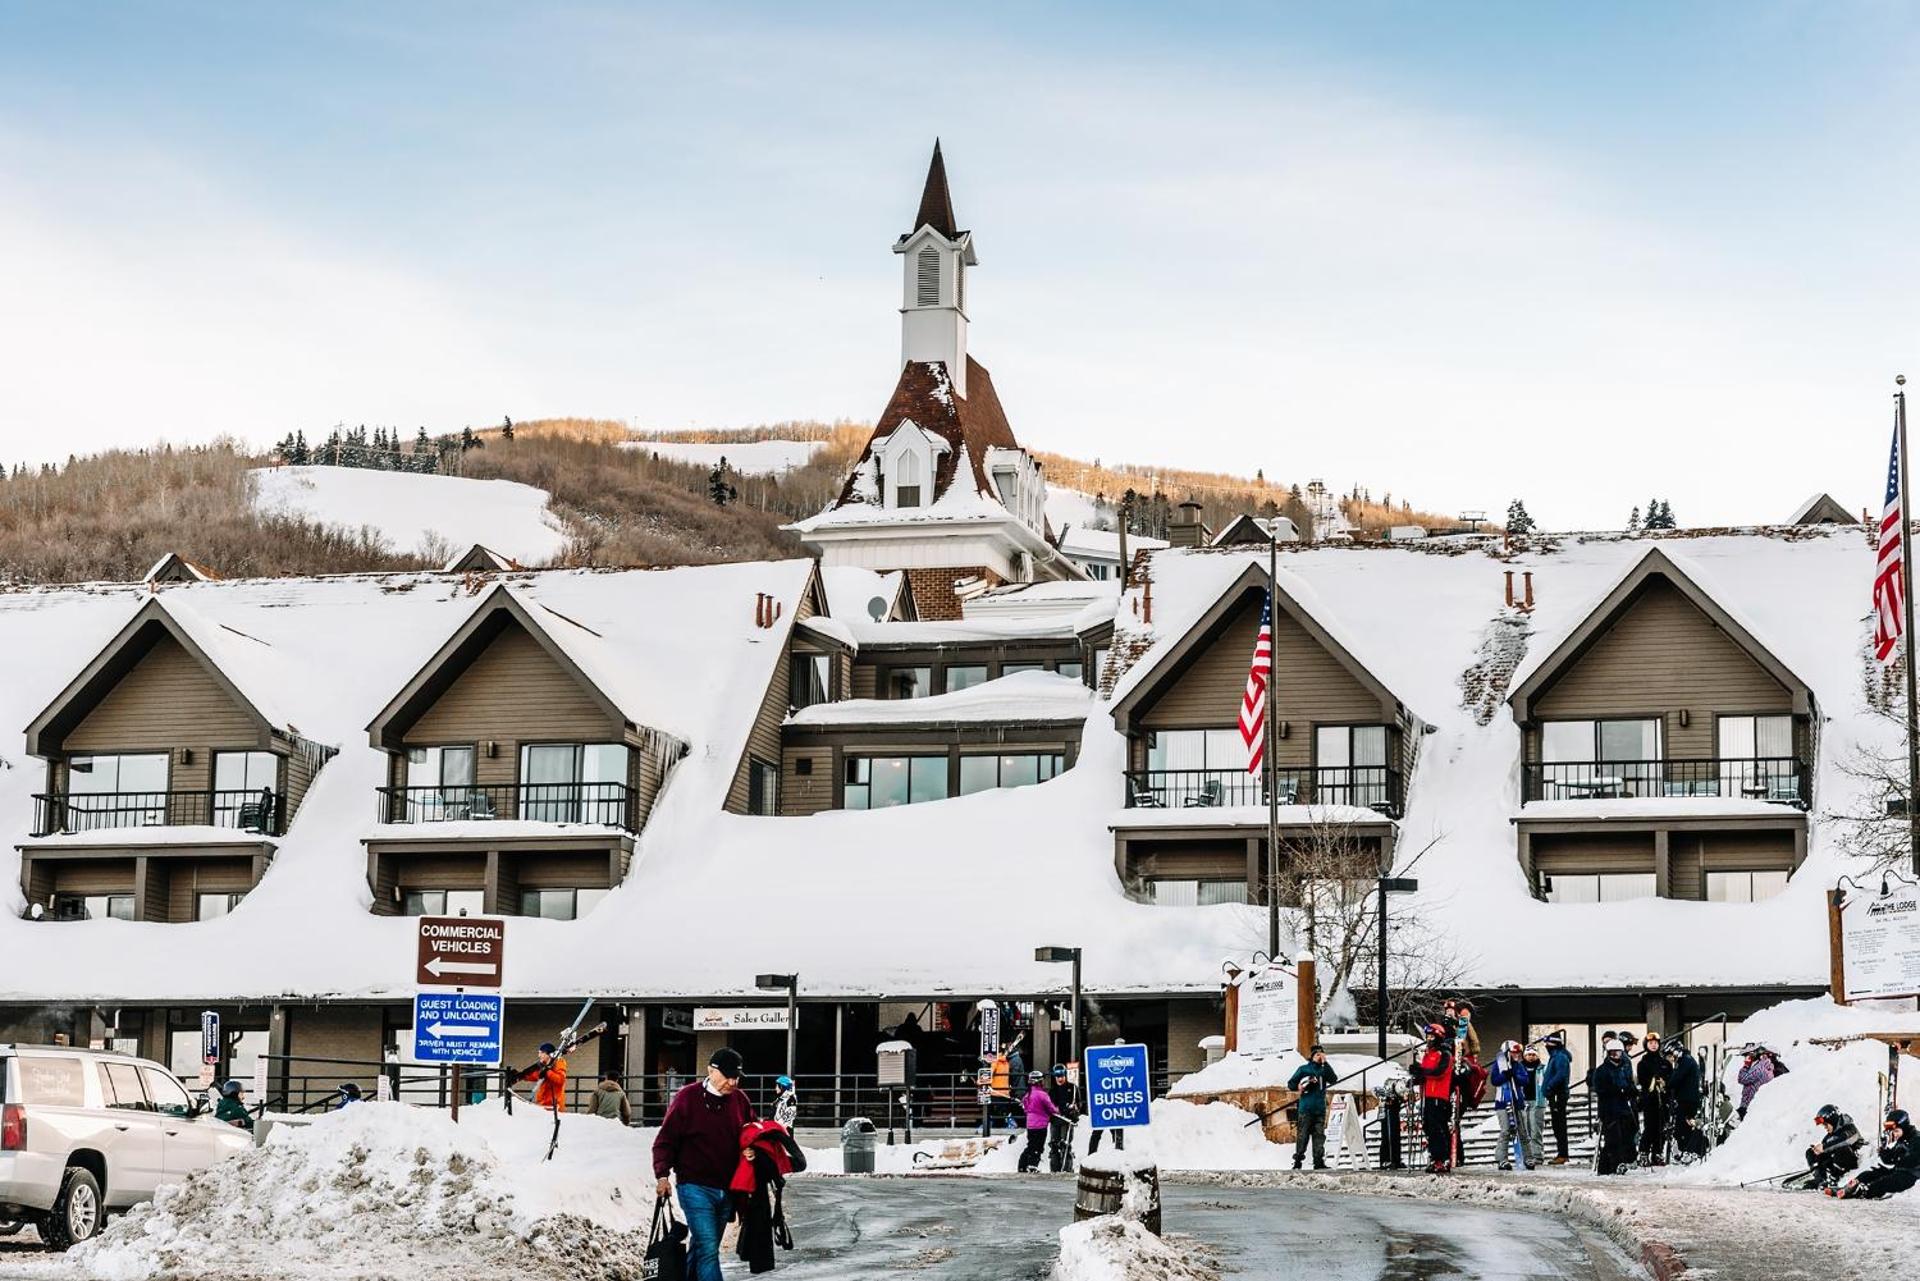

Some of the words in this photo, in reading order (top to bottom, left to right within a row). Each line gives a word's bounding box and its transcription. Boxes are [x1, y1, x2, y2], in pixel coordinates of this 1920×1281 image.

[1896, 900, 1917, 910] LODGE
[421, 925, 502, 939] COMMERCIAL
[431, 940, 491, 954] VEHICLES
[420, 1000, 451, 1010] GUEST
[455, 1000, 498, 1011] LOADING
[419, 1010, 440, 1020] AND
[443, 1011, 498, 1022] UNLOADING
[733, 1012, 758, 1024] Sales
[760, 1012, 790, 1023] Galler
[418, 1039, 445, 1047] DRIVER
[446, 1040, 467, 1048] MUST
[469, 1041, 498, 1049] REMAIN
[452, 1048, 483, 1057] VEHICLE
[1101, 1076, 1134, 1090] CITY
[1094, 1091, 1144, 1105] BUSES
[1101, 1106, 1138, 1121] ONLY
